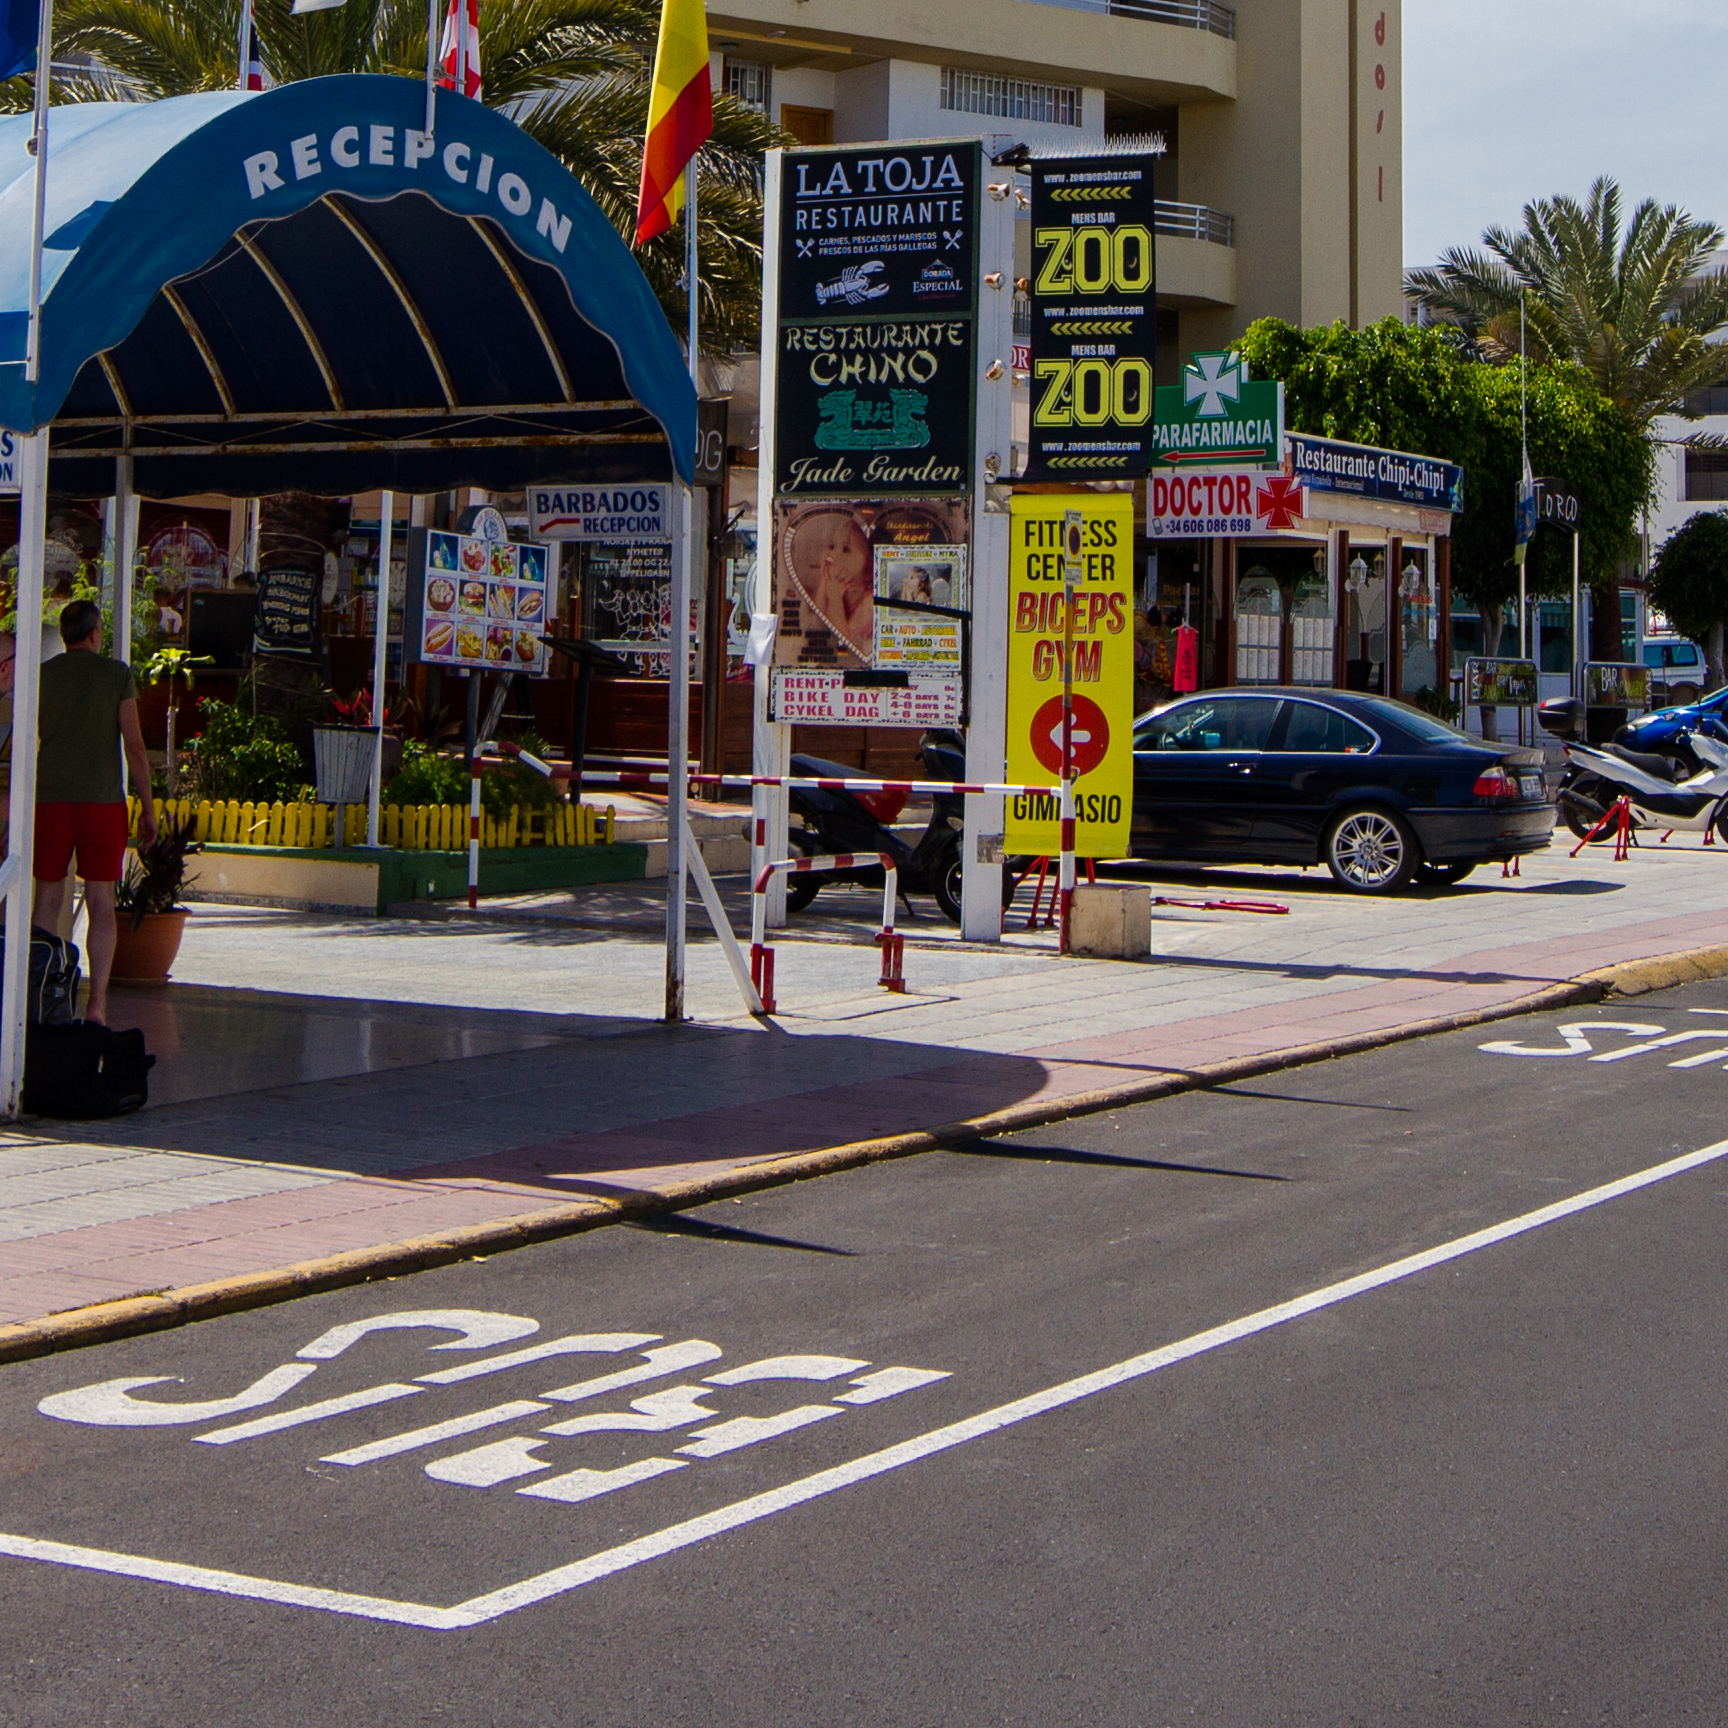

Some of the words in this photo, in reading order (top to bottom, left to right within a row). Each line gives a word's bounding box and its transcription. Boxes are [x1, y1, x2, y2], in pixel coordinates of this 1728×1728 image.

[796, 161, 852, 197] LA
[857, 154, 964, 193] TOJA
[243, 124, 572, 254] RECEPCION
[795, 200, 964, 231] RESTAURANTE
[1071, 213, 1096, 224] MENS
[1097, 212, 1116, 223] BAR
[818, 246, 852, 256] FRESCOS
[853, 245, 863, 254] DE
[864, 244, 879, 254] LAS
[880, 242, 897, 253] RÍAS
[898, 242, 938, 252] GALLEGAS
[852, 234, 891, 245] PESCADOS
[892, 233, 898, 243] Y
[899, 232, 938, 242] MARISCOS
[1035, 224, 1152, 295] ZOO
[923, 270, 952, 278] DORADA
[912, 279, 963, 294] ESPECIAL
[785, 322, 964, 351] RESTAURANTE
[1071, 345, 1096, 356] MENS
[1097, 344, 1116, 355] BAR
[809, 349, 938, 386] CHINO
[1034, 357, 1153, 427] ZOO
[1152, 419, 1274, 449] PARAFARMACIA
[780, 455, 856, 494] Jade
[862, 453, 965, 483] Garden
[1296, 441, 1376, 479] Restaurante
[1378, 455, 1445, 497] Chipi-Chipi
[536, 491, 660, 514] BARBADOS
[1153, 475, 1252, 517] DOCTOR
[583, 516, 661, 533] RECEPCION
[1165, 520, 1181, 533] +34
[1183, 519, 1204, 533] 606
[1206, 519, 1227, 532] 086
[1229, 518, 1251, 532] 698
[1015, 591, 1127, 634] BICEPS
[880, 624, 894, 635] CAR
[1031, 639, 1103, 683] GYM
[784, 677, 826, 689] RENT
[1601, 666, 1618, 692] BAR
[784, 691, 829, 703] BIKE
[843, 692, 880, 703] DAY
[890, 691, 912, 700] 2-4
[784, 704, 835, 716] CYKEL
[845, 706, 880, 717] DAG
